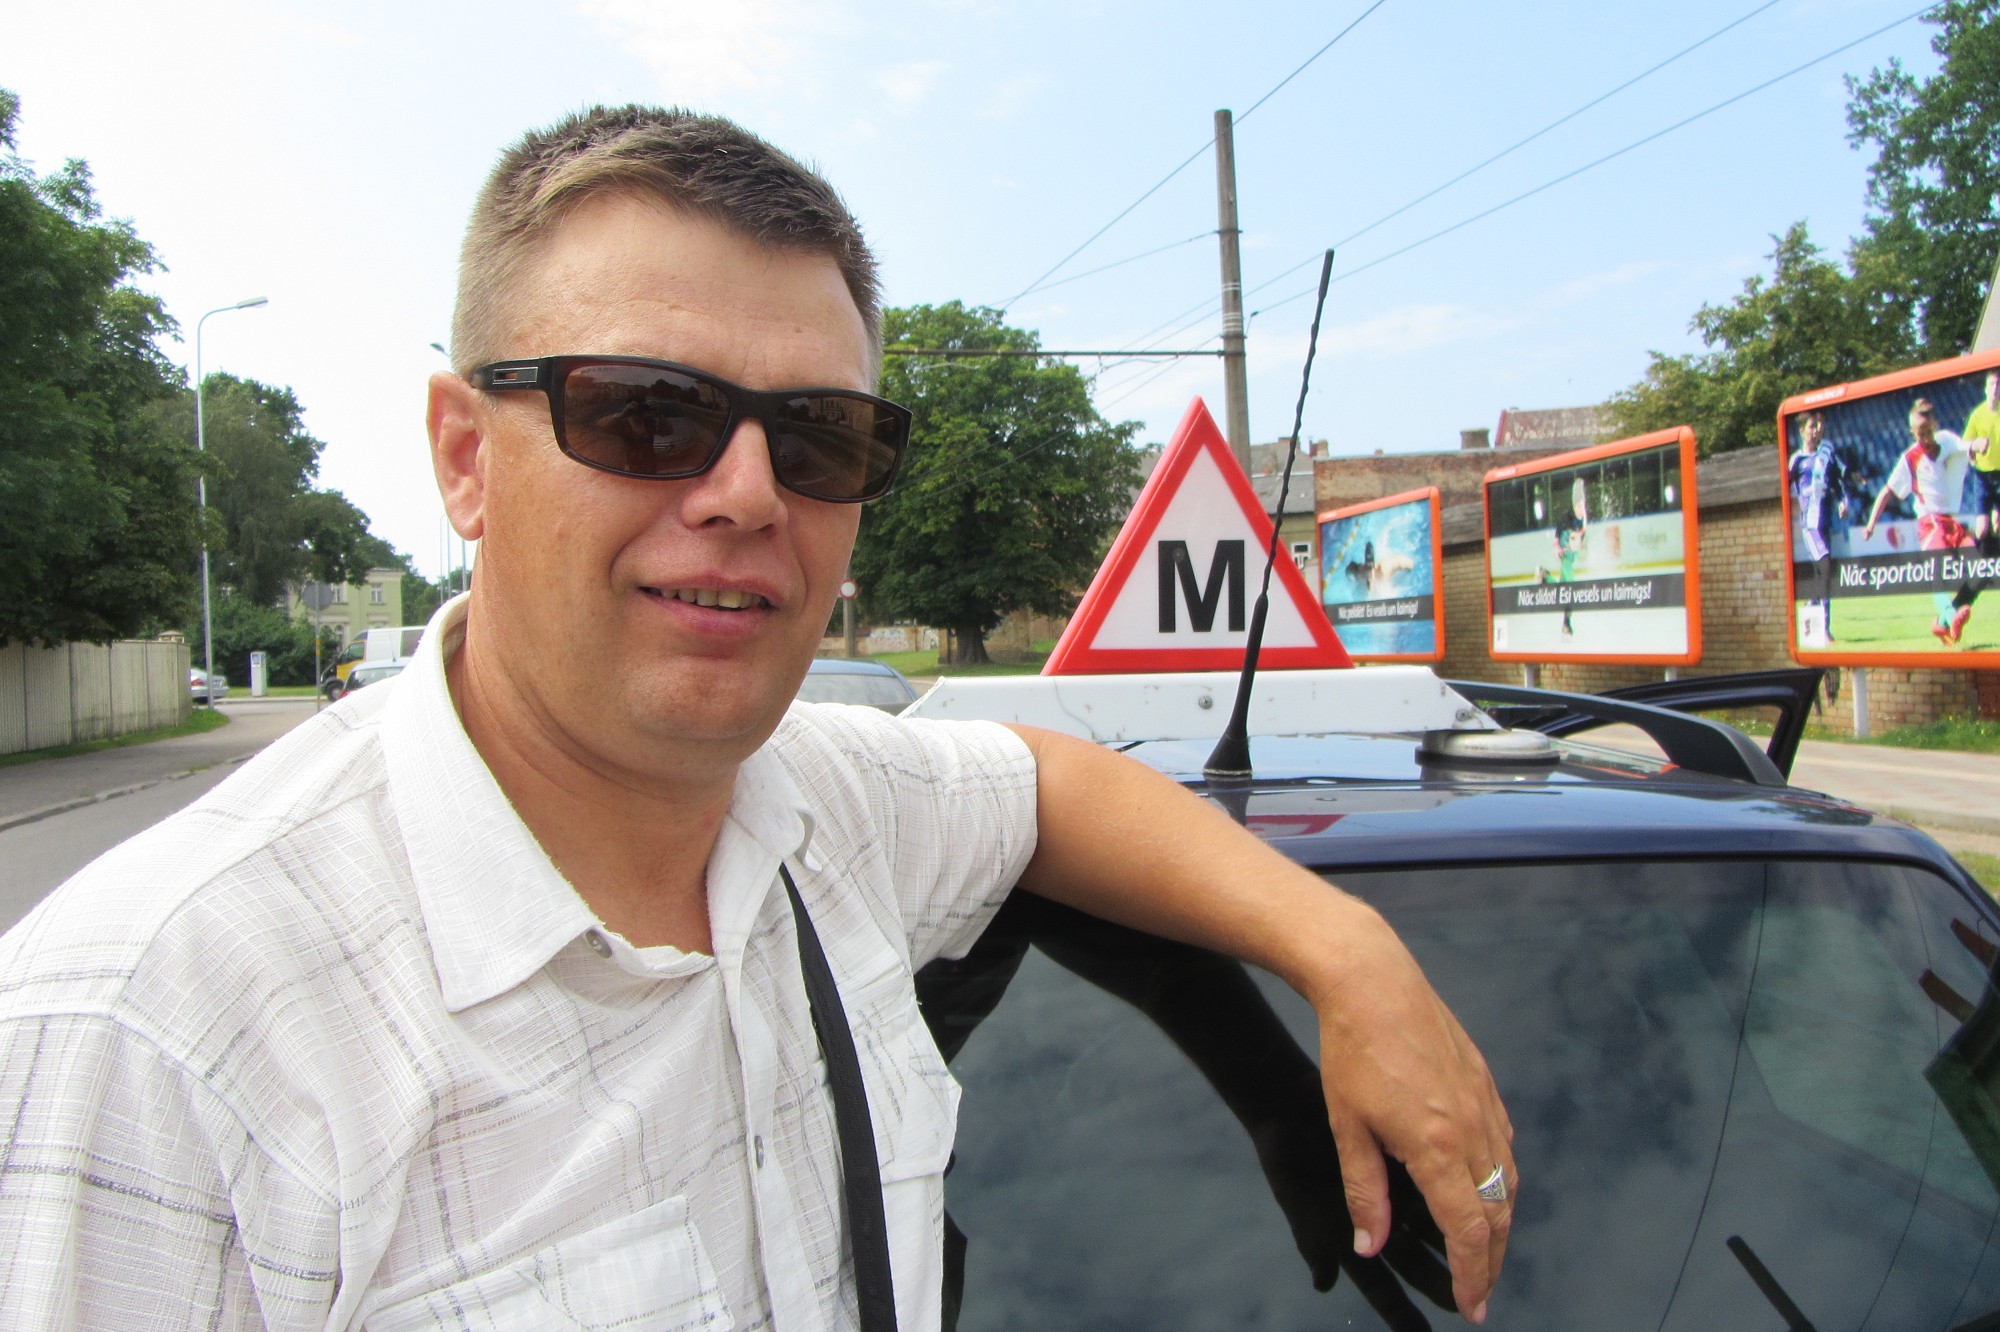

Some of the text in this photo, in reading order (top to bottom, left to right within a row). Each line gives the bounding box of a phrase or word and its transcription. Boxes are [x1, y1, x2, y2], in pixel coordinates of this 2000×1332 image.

[1158, 539, 1245, 633] M
[1869, 557, 1936, 590] sportot!
[1942, 555, 1965, 580] Esi
[1559, 586, 1572, 604] Esi
[1573, 584, 1600, 603] vesels
[1601, 587, 1613, 602] un
